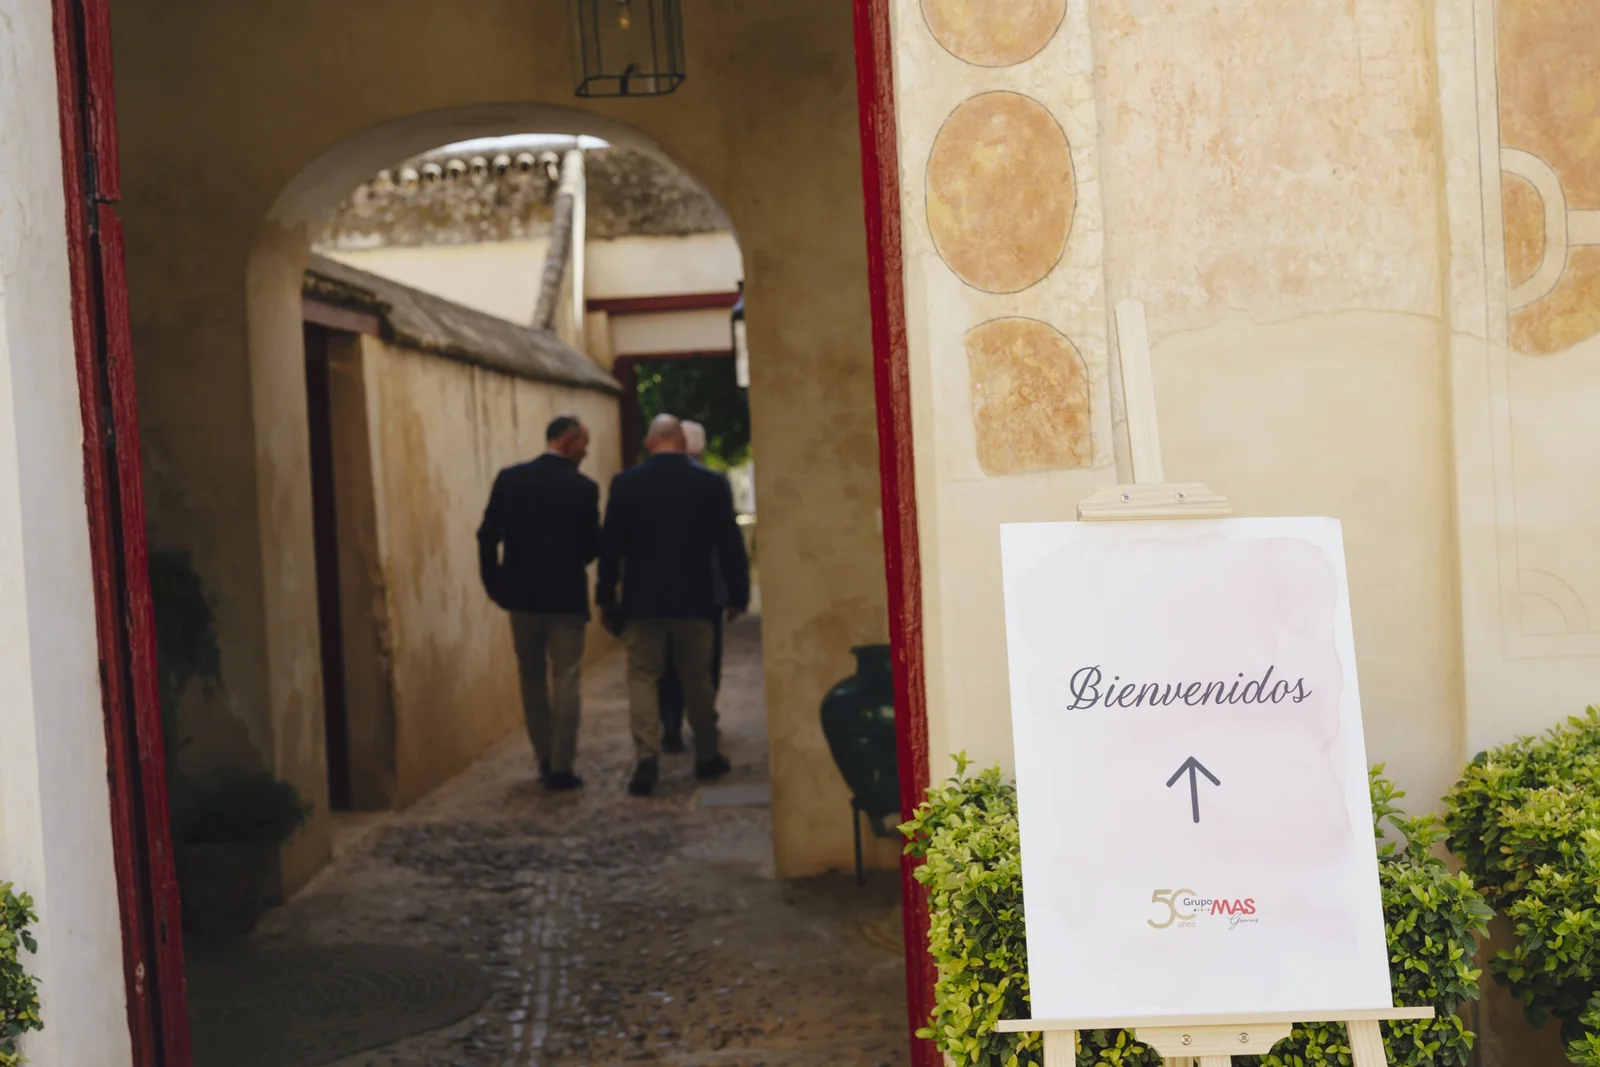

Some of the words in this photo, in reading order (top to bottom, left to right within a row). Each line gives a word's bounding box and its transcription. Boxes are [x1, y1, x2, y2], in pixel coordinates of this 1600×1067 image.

[1066, 664, 1312, 711] Bienvenidos
[1183, 897, 1213, 907] Grupo
[1210, 898, 1256, 915] MAS
